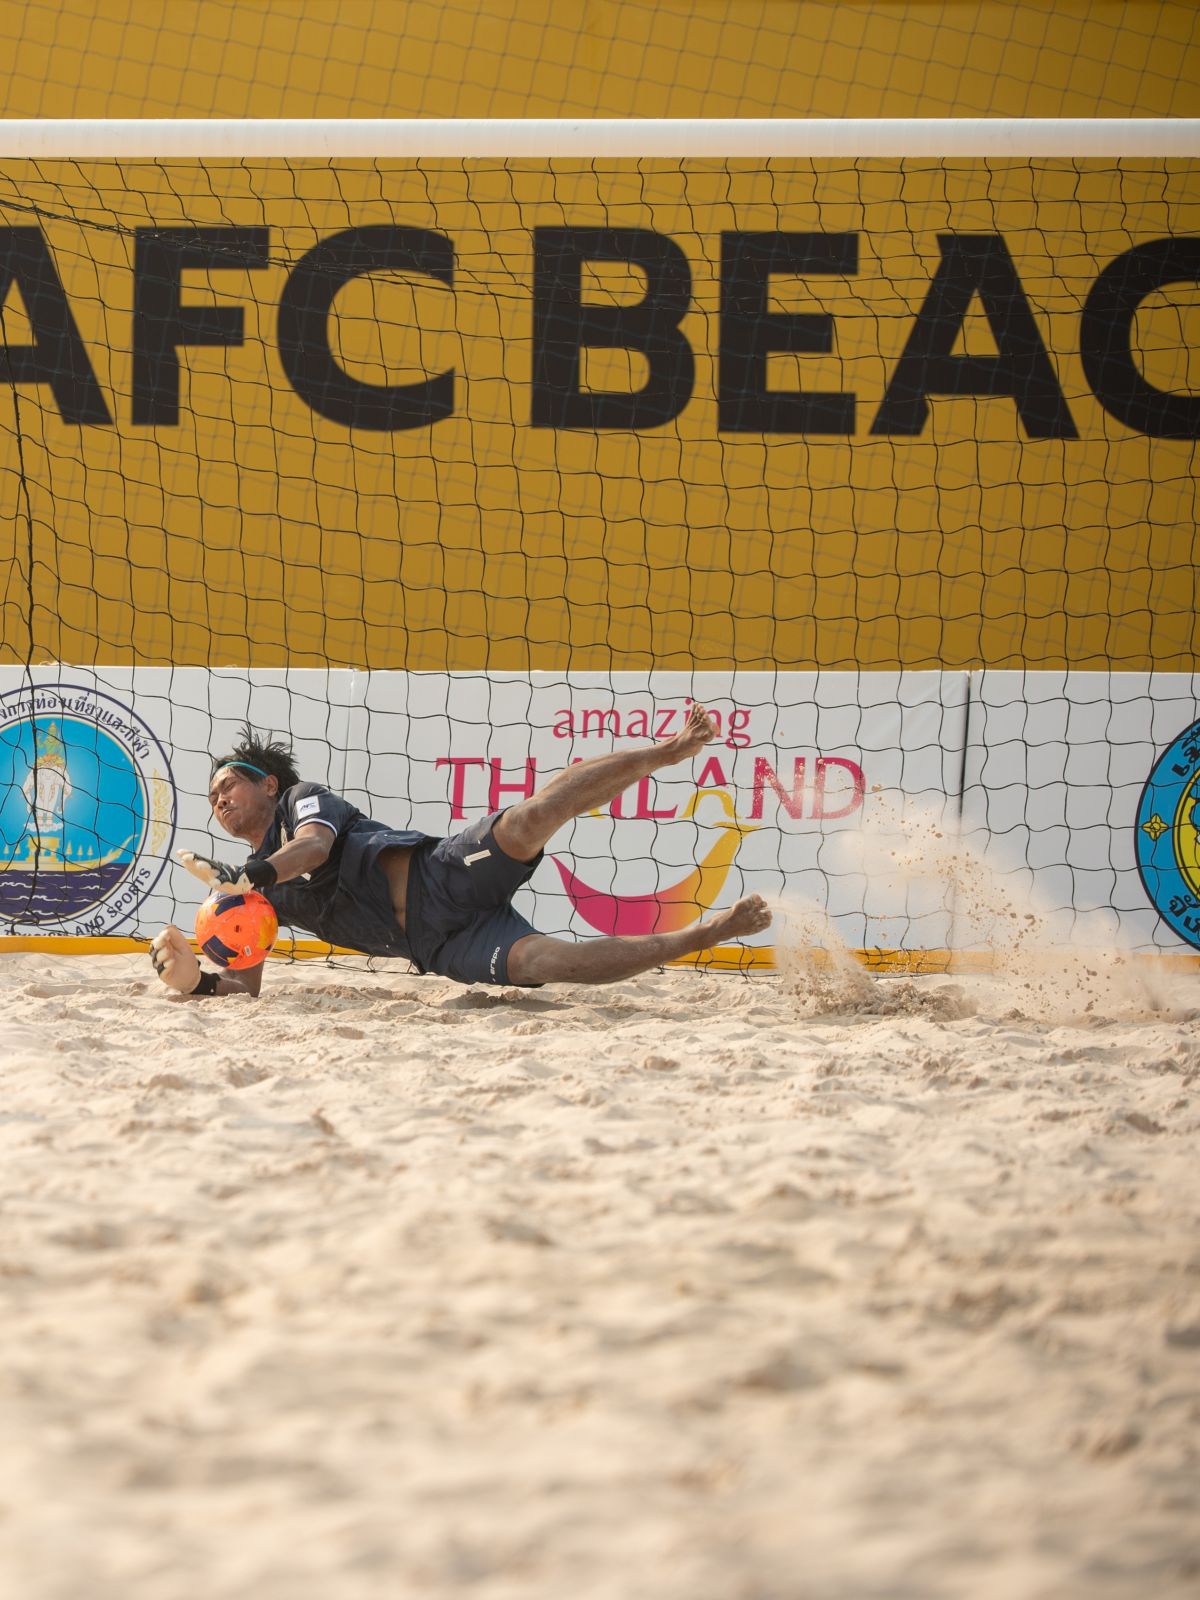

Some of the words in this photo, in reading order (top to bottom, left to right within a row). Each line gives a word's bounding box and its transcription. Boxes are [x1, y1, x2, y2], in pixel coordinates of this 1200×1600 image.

[435, 756, 866, 820] THLAND
[464, 849, 493, 867] 1
[107, 868, 151, 918] SPORTS
